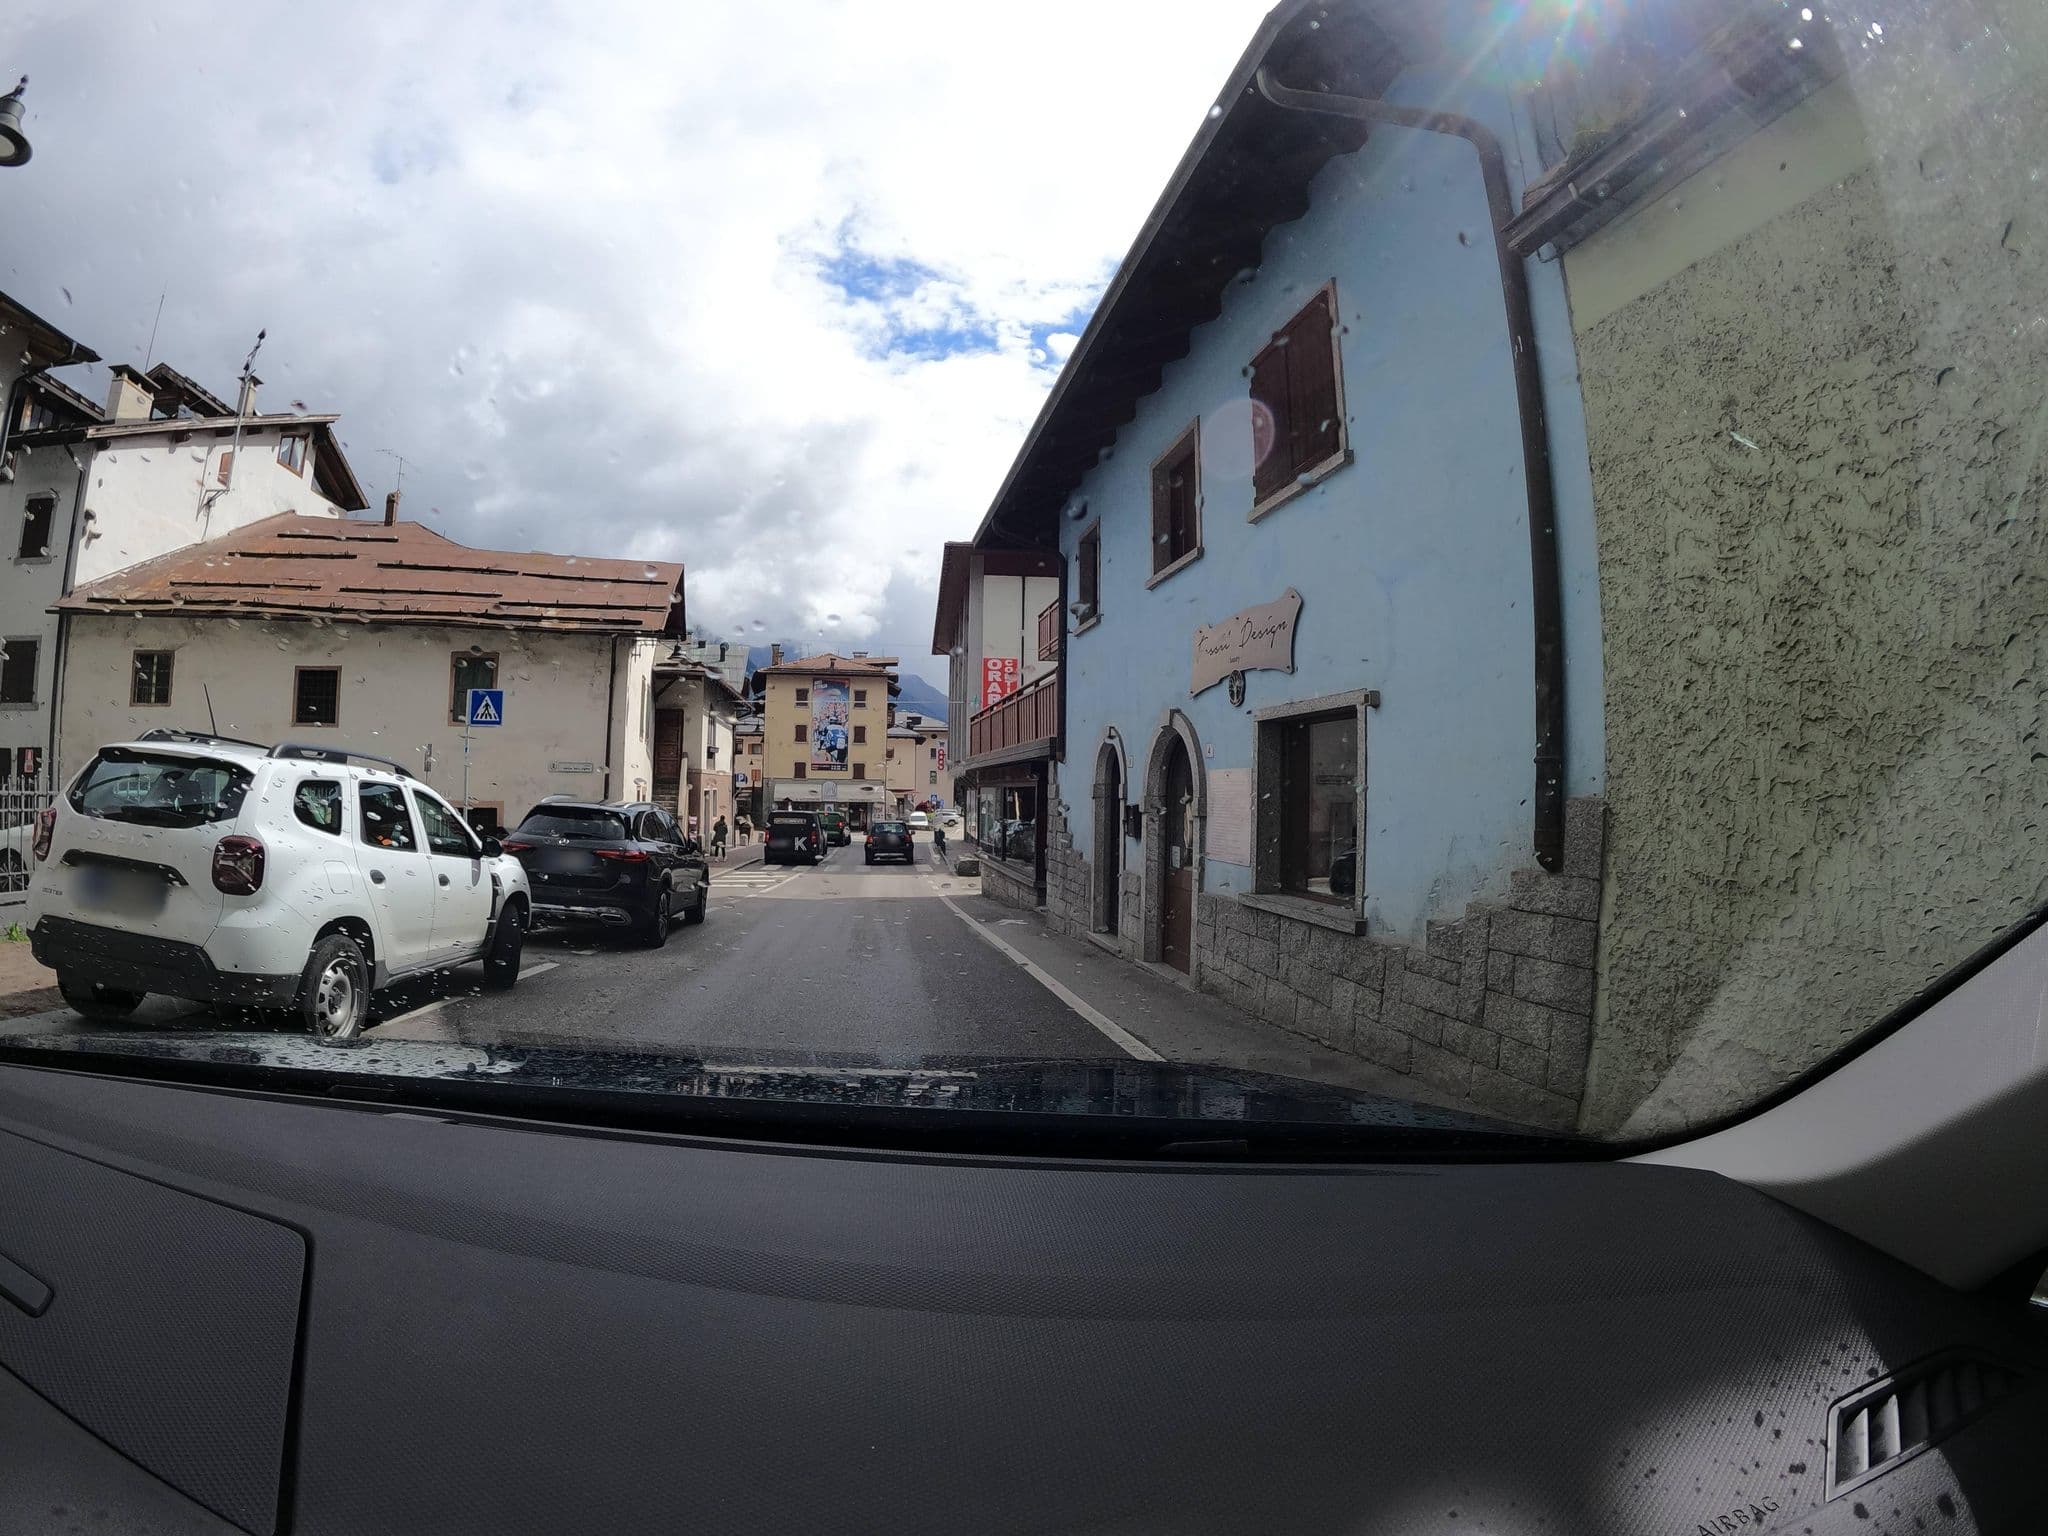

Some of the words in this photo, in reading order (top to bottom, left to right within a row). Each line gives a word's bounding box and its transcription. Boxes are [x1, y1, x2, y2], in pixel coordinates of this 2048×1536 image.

[1238, 616, 1288, 648] Design
[795, 837, 807, 850] K
[1697, 1496, 1780, 1536] AIRBAG
